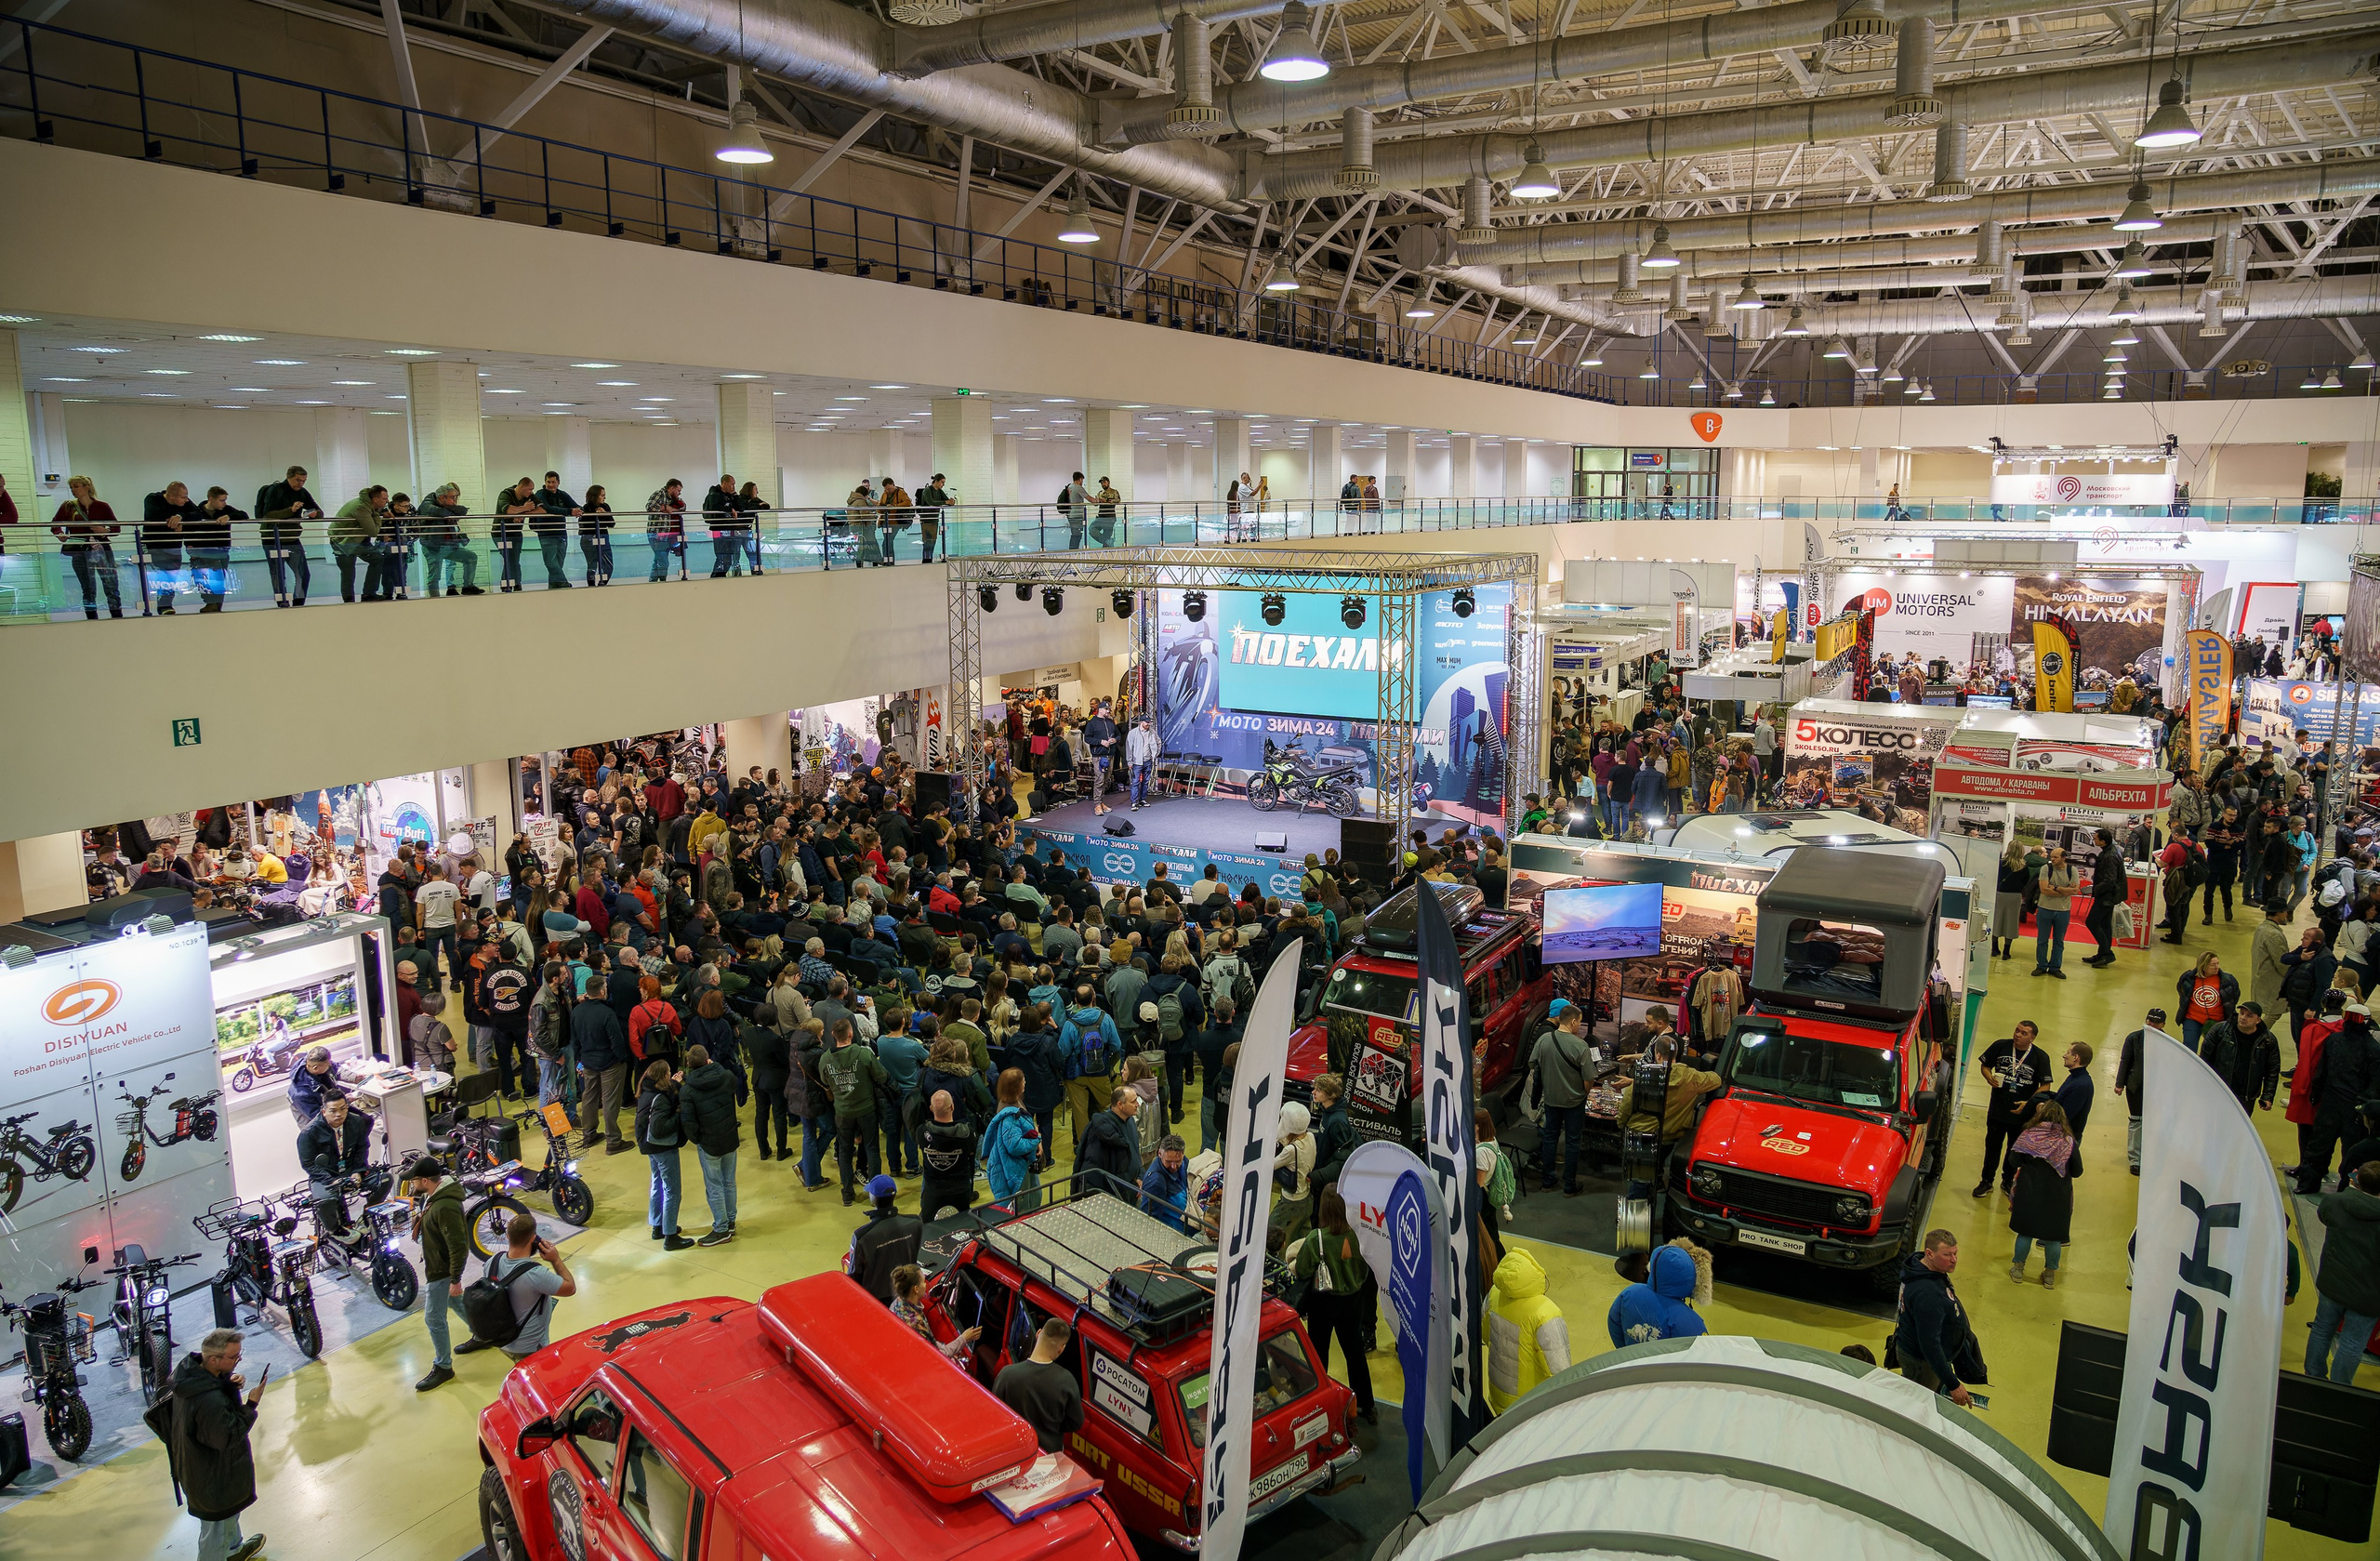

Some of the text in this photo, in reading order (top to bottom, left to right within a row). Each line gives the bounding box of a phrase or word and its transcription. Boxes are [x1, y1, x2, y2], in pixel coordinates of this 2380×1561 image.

[1867, 597, 1887, 609] UM
[1896, 592, 1976, 606] UNIVERSAL
[2052, 592, 2127, 604] ROYAL ENFIELD
[1809, 606, 1818, 623] UM
[1896, 604, 1955, 616] MOTORS
[2025, 604, 2153, 623] HIMALAYAN
[1230, 632, 1408, 673] ПОЕХАЛИ
[1218, 714, 1336, 736] МОТО ЗИМА 24
[1844, 721, 1893, 730] АВТОМОБИЛЬНЫЙ
[1795, 719, 1917, 749] 5КОЛЕСО
[1794, 744, 1840, 753] 5KOLESO.RU
[1961, 775, 2001, 787] АВТОДОМА
[2008, 778, 2050, 790] КАРАВАНЫ
[1974, 786, 2035, 795] www.albrehta.ru
[2088, 787, 2147, 802] АЛЬБРЕХТА
[382, 820, 427, 840] Iron Butt
[1090, 839, 1108, 847] МОТО
[1110, 840, 1130, 850] ЗИМА
[1212, 853, 1266, 866] МОТО ЗИМА 24
[1111, 879, 1131, 887] ЗИМА
[1690, 874, 1768, 895] ПОЕХА
[1662, 903, 1684, 916] ED
[1945, 921, 1961, 930] RED
[1665, 933, 1704, 945] OFFROA
[1660, 944, 1698, 956] ВГЕНИЙ
[505, 970, 527, 987] ANGELS
[496, 1001, 521, 1011] RUSSIA
[44, 1022, 127, 1053] DISIYUAN
[1376, 1031, 1401, 1044] RED
[14, 1025, 181, 1078] Foshan Disiyuan Electric Vehicle Co.,Ltd
[1343, 1042, 1362, 1104] ЕМЛЯ ВОГУЛОВ
[1351, 1101, 1374, 1115] СЛОН
[1354, 1089, 1396, 1113] КОЧУЮЩИЙ
[1348, 1117, 1402, 1136] ЕСТИВАЛЬ
[1352, 1126, 1402, 1143] ГРАФИЧЕСКИХ
[26, 1142, 47, 1160] DISIYUAN
[1765, 1140, 1806, 1153] RED
[1360, 1201, 1385, 1228] LY
[1360, 1223, 1382, 1237] SPARE
[1401, 1214, 1418, 1252] NGN
[1759, 1237, 1779, 1246] TANK
[1783, 1242, 1804, 1250] SHOP
[1106, 1366, 1145, 1399] РОСАТОМ
[1186, 1390, 1202, 1400] IKON
[1107, 1393, 1136, 1417] LYNX
[1289, 1457, 1305, 1473] 790
[986, 1468, 1018, 1483] EVEREST
[1040, 1474, 1068, 1487] РОССИИ
[1072, 1433, 1181, 1517] ORT USSR
